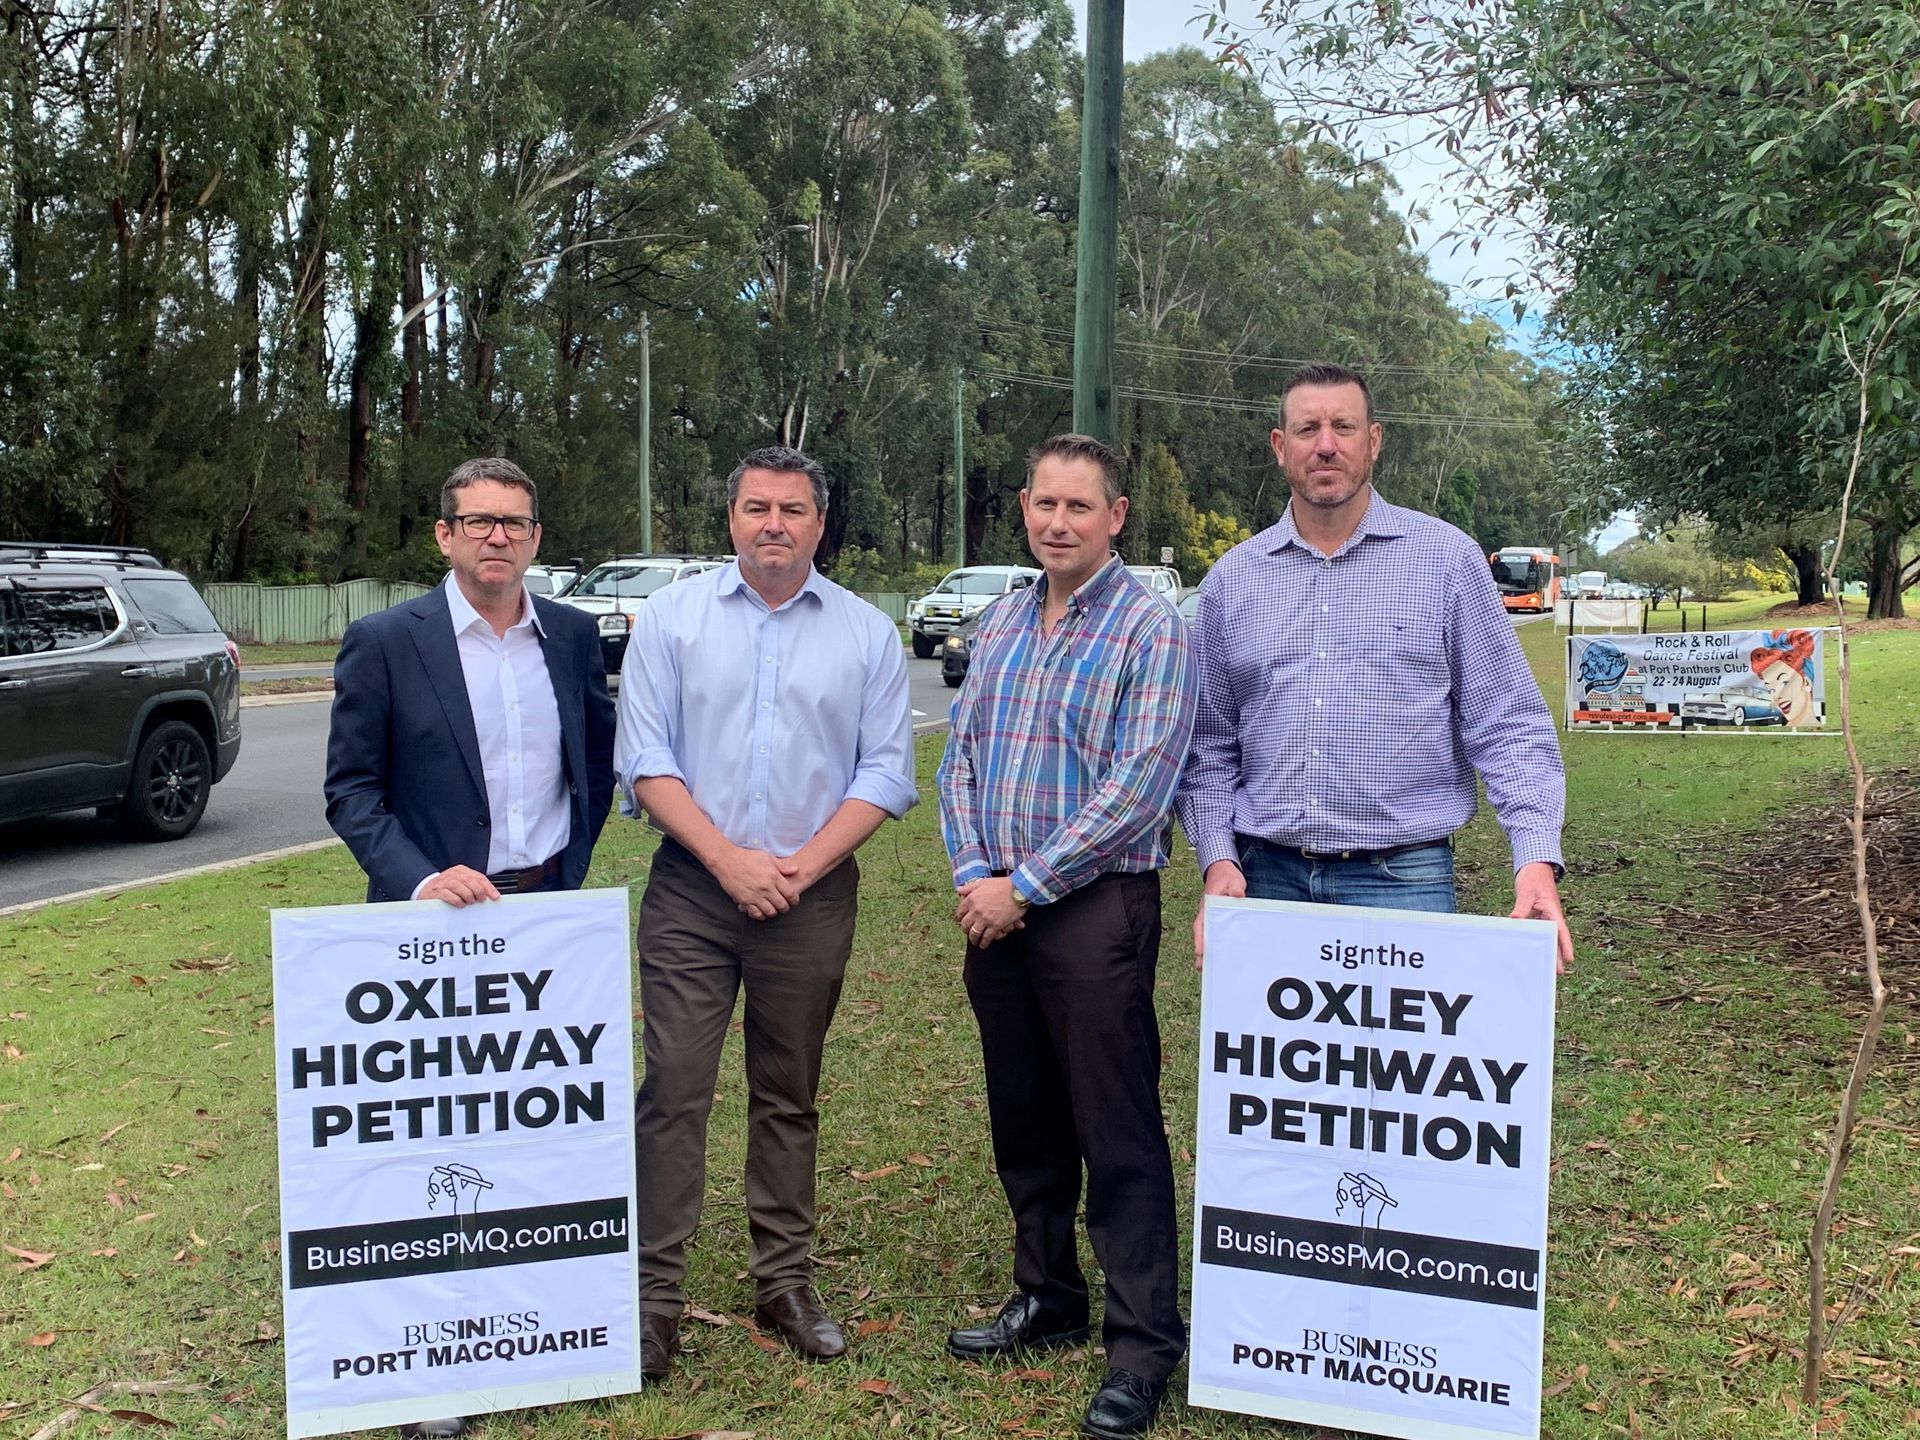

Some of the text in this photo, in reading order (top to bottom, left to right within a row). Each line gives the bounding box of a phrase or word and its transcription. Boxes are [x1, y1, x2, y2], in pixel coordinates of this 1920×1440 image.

[1643, 648, 1739, 661] Dance Festival
[1655, 634, 1730, 648] Rock & Roll
[1638, 663, 1749, 674] at Port Panthers Club
[1653, 676, 1665, 687] 22
[1672, 676, 1684, 687] 24
[1686, 675, 1722, 688] August
[346, 969, 553, 1024] OXLEY
[1267, 977, 1473, 1036] OXLEY
[292, 1023, 606, 1089] HIGHWAY
[1214, 1031, 1528, 1104] HIGHWAY
[312, 1081, 604, 1148] PETITION
[1229, 1093, 1521, 1168] PETITION
[307, 1217, 627, 1270] BusinessPMQ.com.au
[1217, 1225, 1538, 1292] BusinessPMQ.com.au
[333, 1326, 609, 1379] PORT MACQUARIE
[404, 1311, 539, 1346] BUSINESS
[1302, 1329, 1437, 1368] BUSINESS
[1233, 1344, 1511, 1406] PORT MACQUARIE
